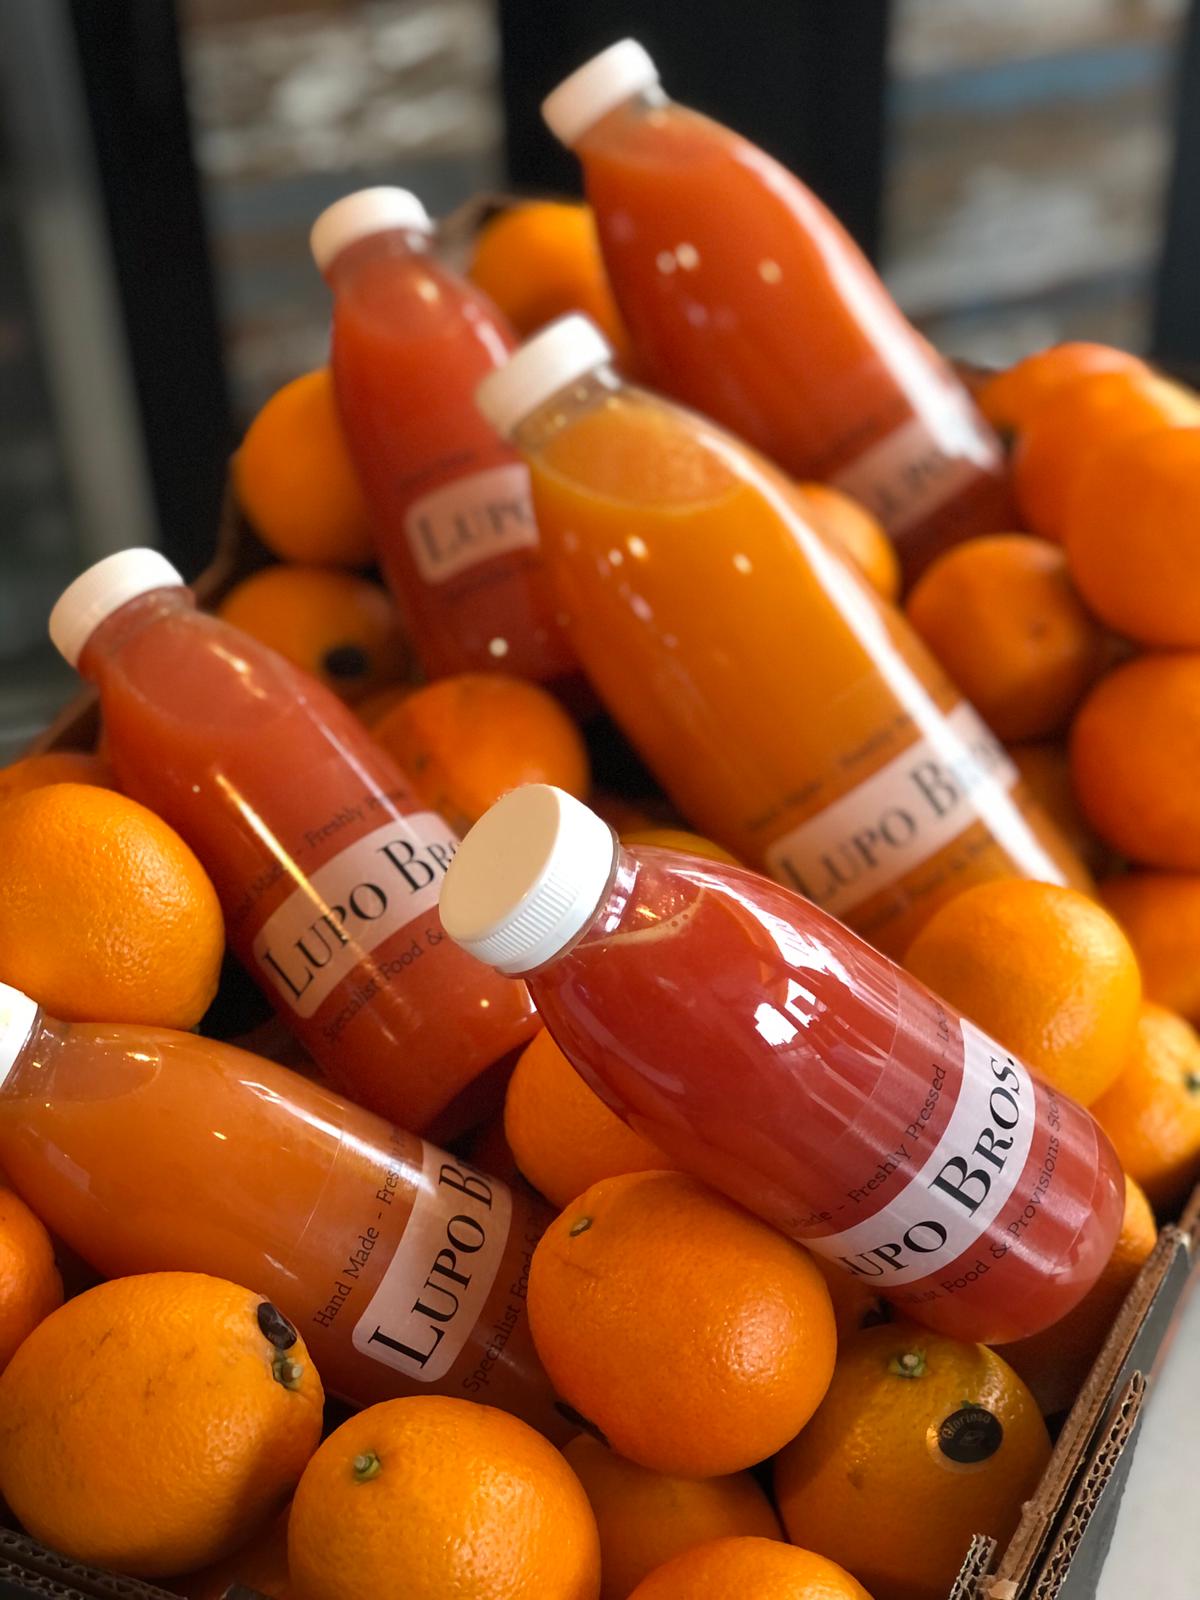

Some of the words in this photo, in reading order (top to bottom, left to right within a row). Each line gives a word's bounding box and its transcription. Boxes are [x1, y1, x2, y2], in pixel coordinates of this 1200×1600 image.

[264, 882, 389, 1003] LUPO
[380, 941, 425, 983] Food
[426, 927, 444, 945] &
[846, 1144, 914, 1206] Freshly
[905, 1063, 948, 1141] Pressed
[927, 1055, 1021, 1218] BROS.
[313, 1279, 353, 1329] Hand
[343, 1225, 381, 1281] Made
[940, 1259, 991, 1295] Food
[990, 1241, 1008, 1258] &
[1006, 1137, 1060, 1239] Provisions
[367, 1213, 487, 1370] LUPO
[462, 1305, 521, 1394] Specialist
